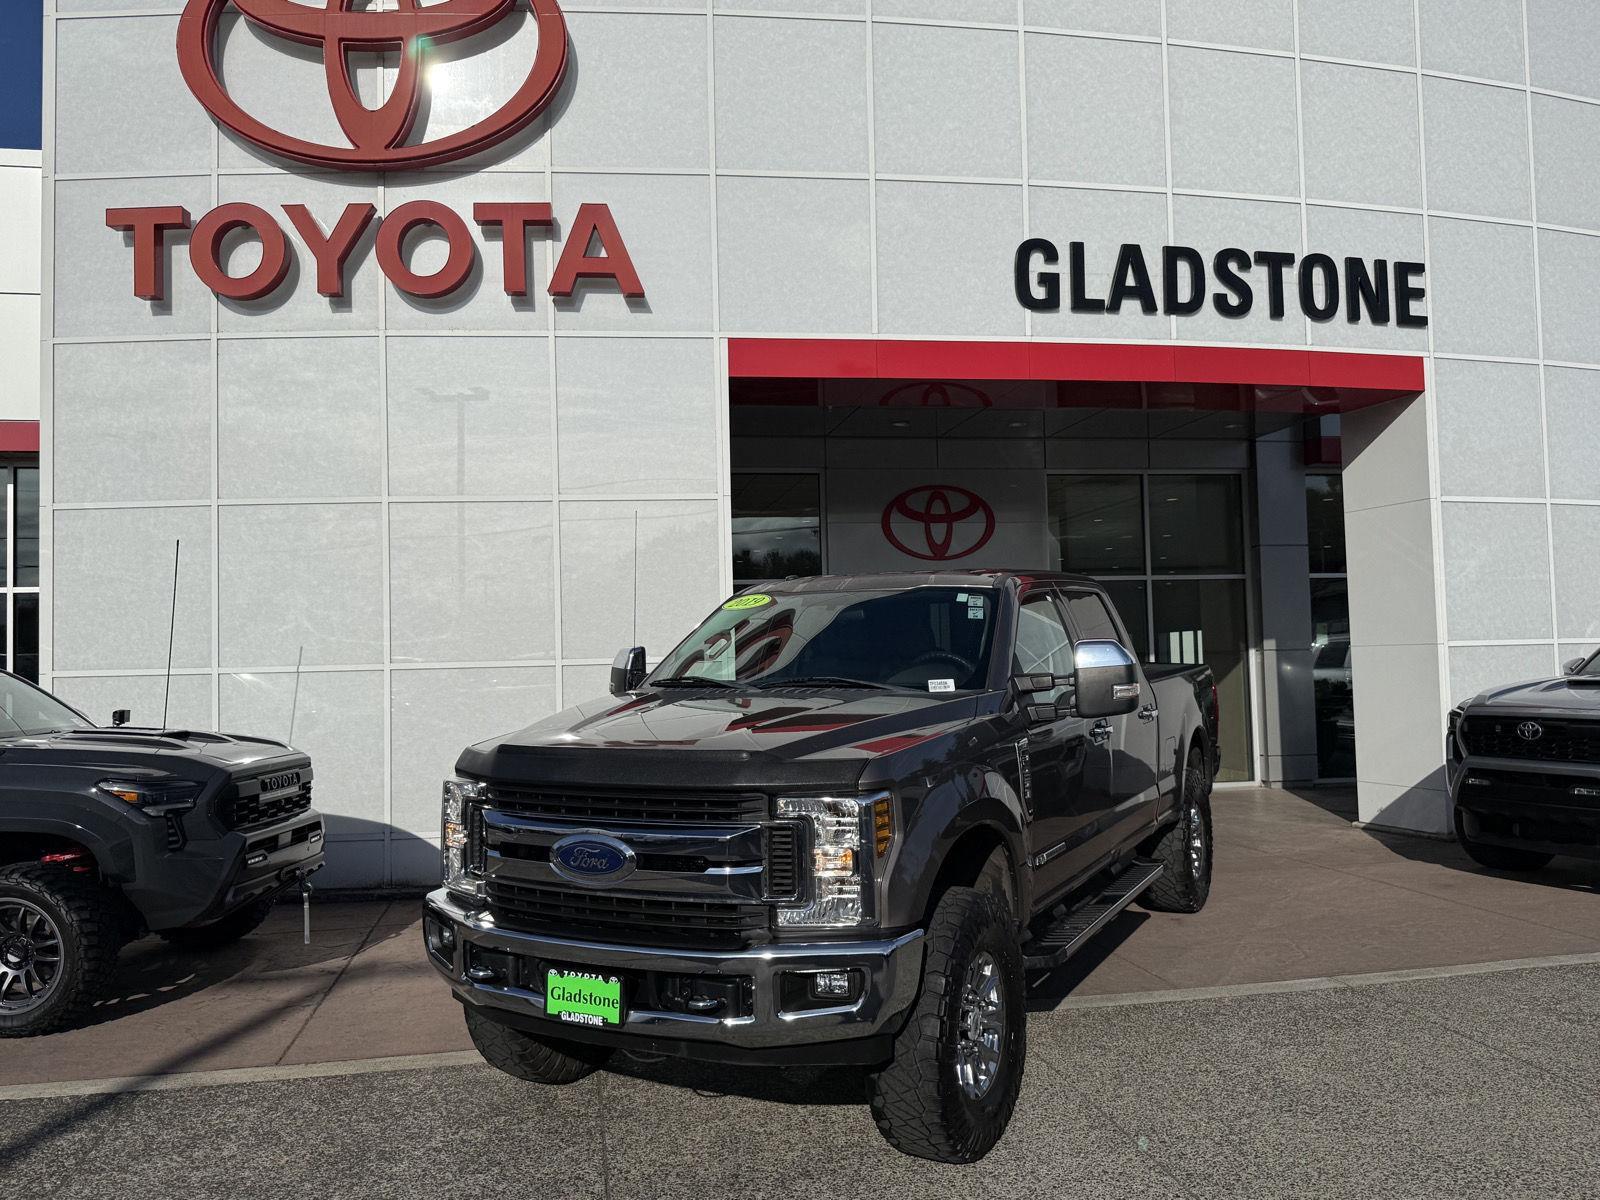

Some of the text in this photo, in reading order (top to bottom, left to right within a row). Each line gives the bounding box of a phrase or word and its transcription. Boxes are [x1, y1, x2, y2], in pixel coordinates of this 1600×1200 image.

[106, 200, 645, 300] TOYOTA
[1014, 238, 1428, 328] GLADSTONE
[266, 773, 299, 790] TOYOTA
[570, 847, 610, 869] Ford
[563, 970, 604, 981] TOYOTA
[550, 986, 619, 1009] Gladstone
[561, 1011, 604, 1026] GLADSTONE
